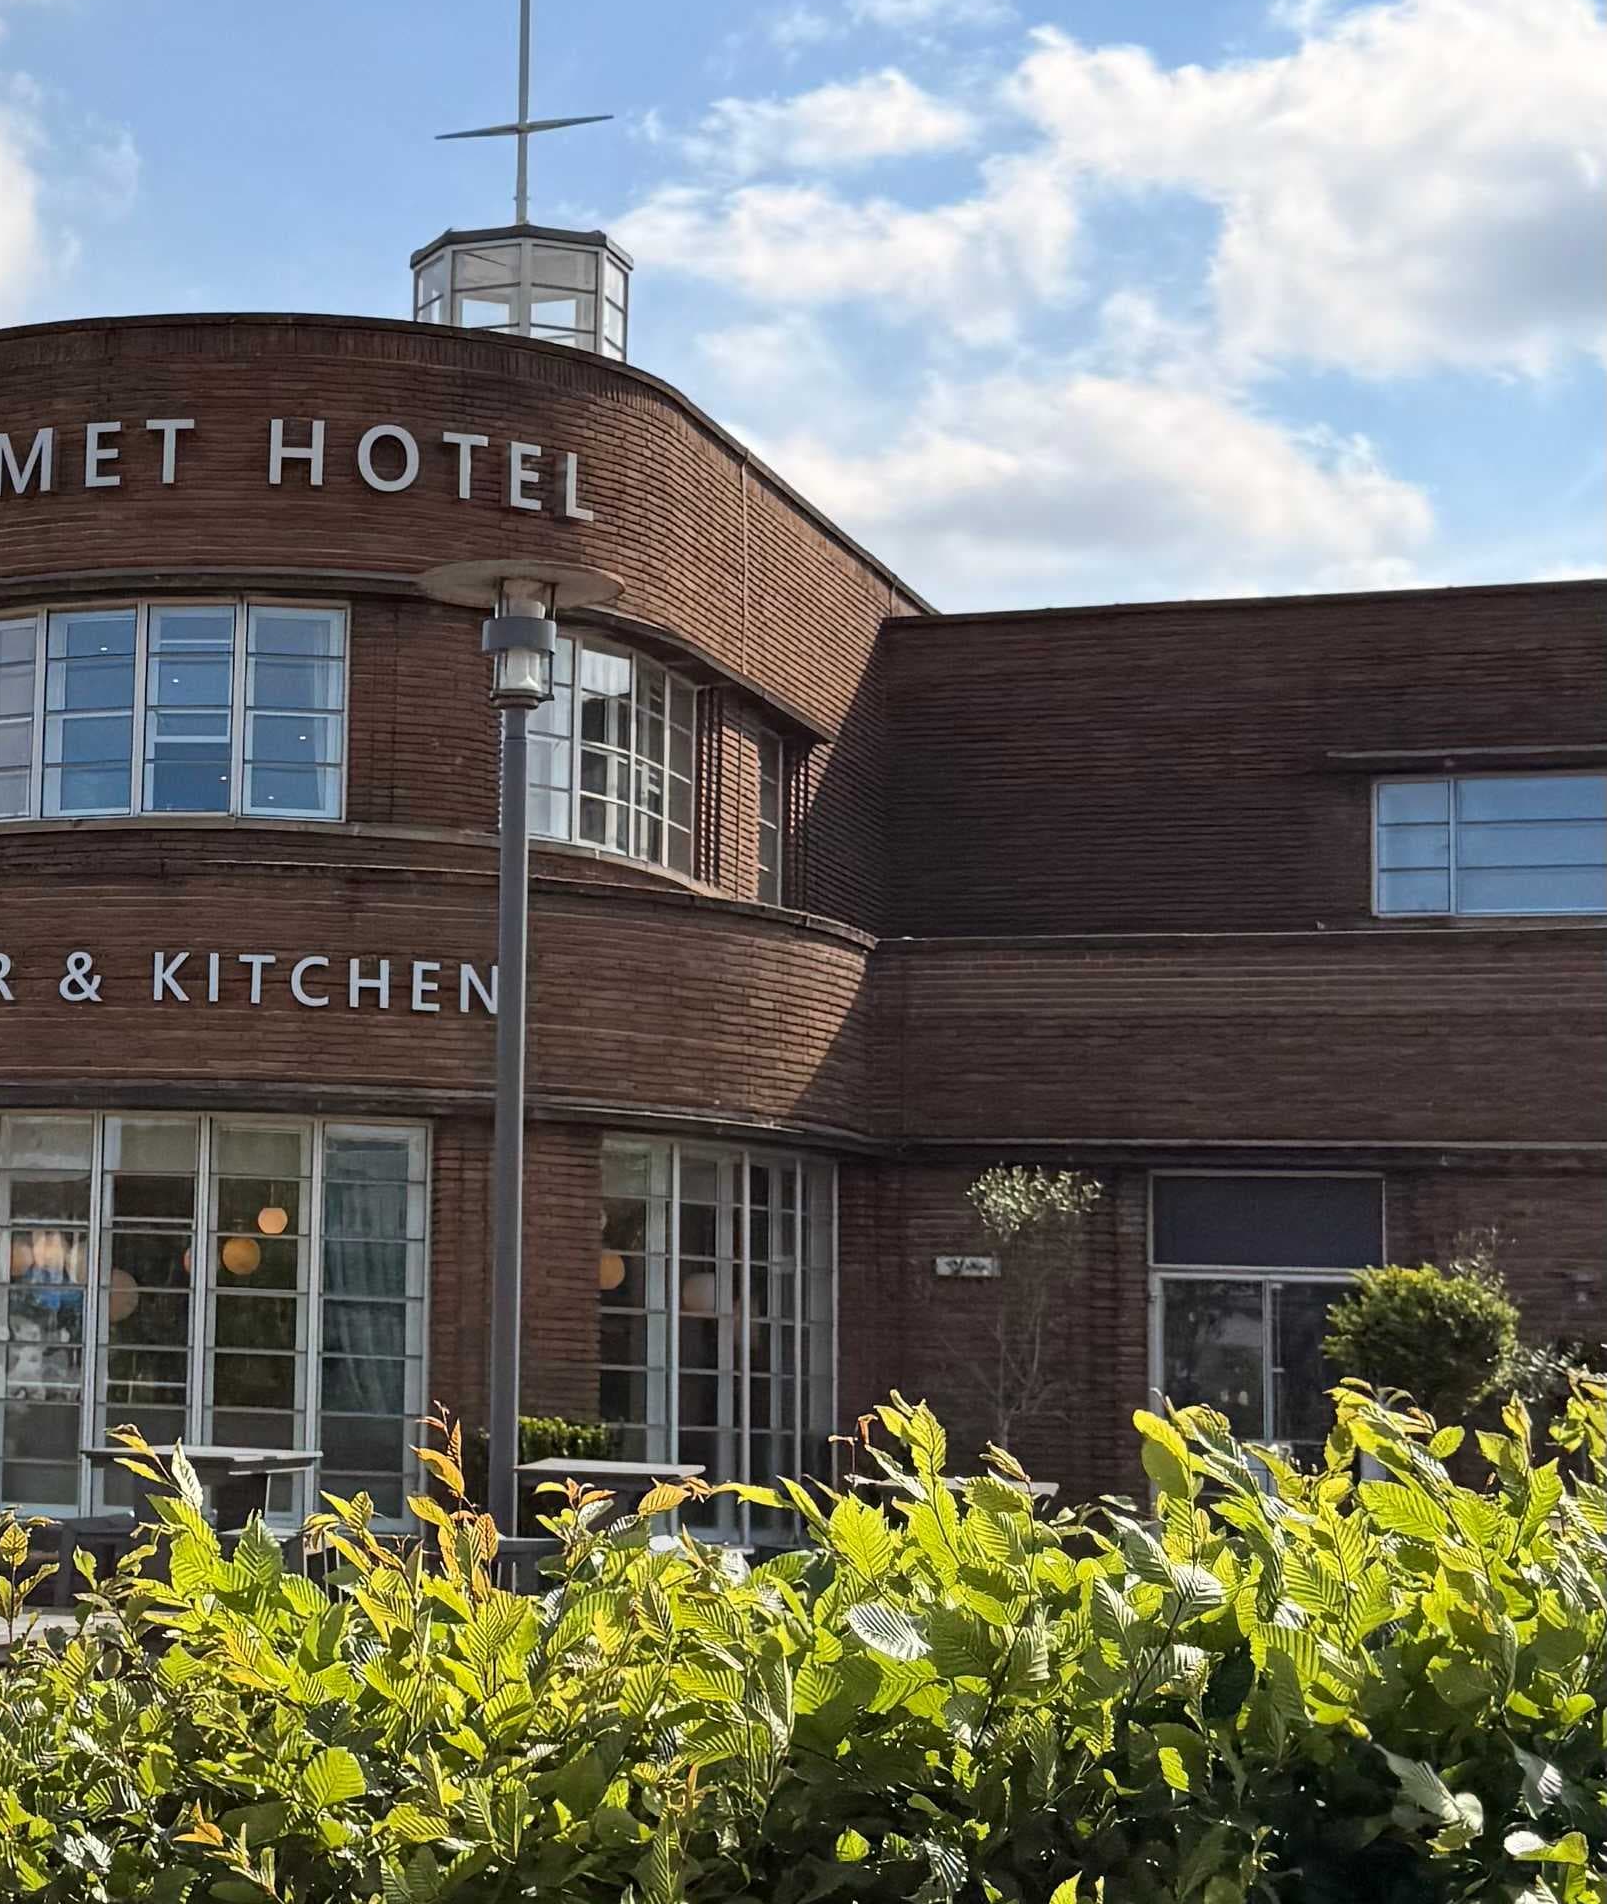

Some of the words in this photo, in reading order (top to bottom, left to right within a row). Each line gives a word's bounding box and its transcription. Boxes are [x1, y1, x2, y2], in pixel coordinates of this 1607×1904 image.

[269, 418, 596, 522] HOTEL
[59, 951, 102, 1003] &
[153, 951, 499, 1015] KITCHEN
